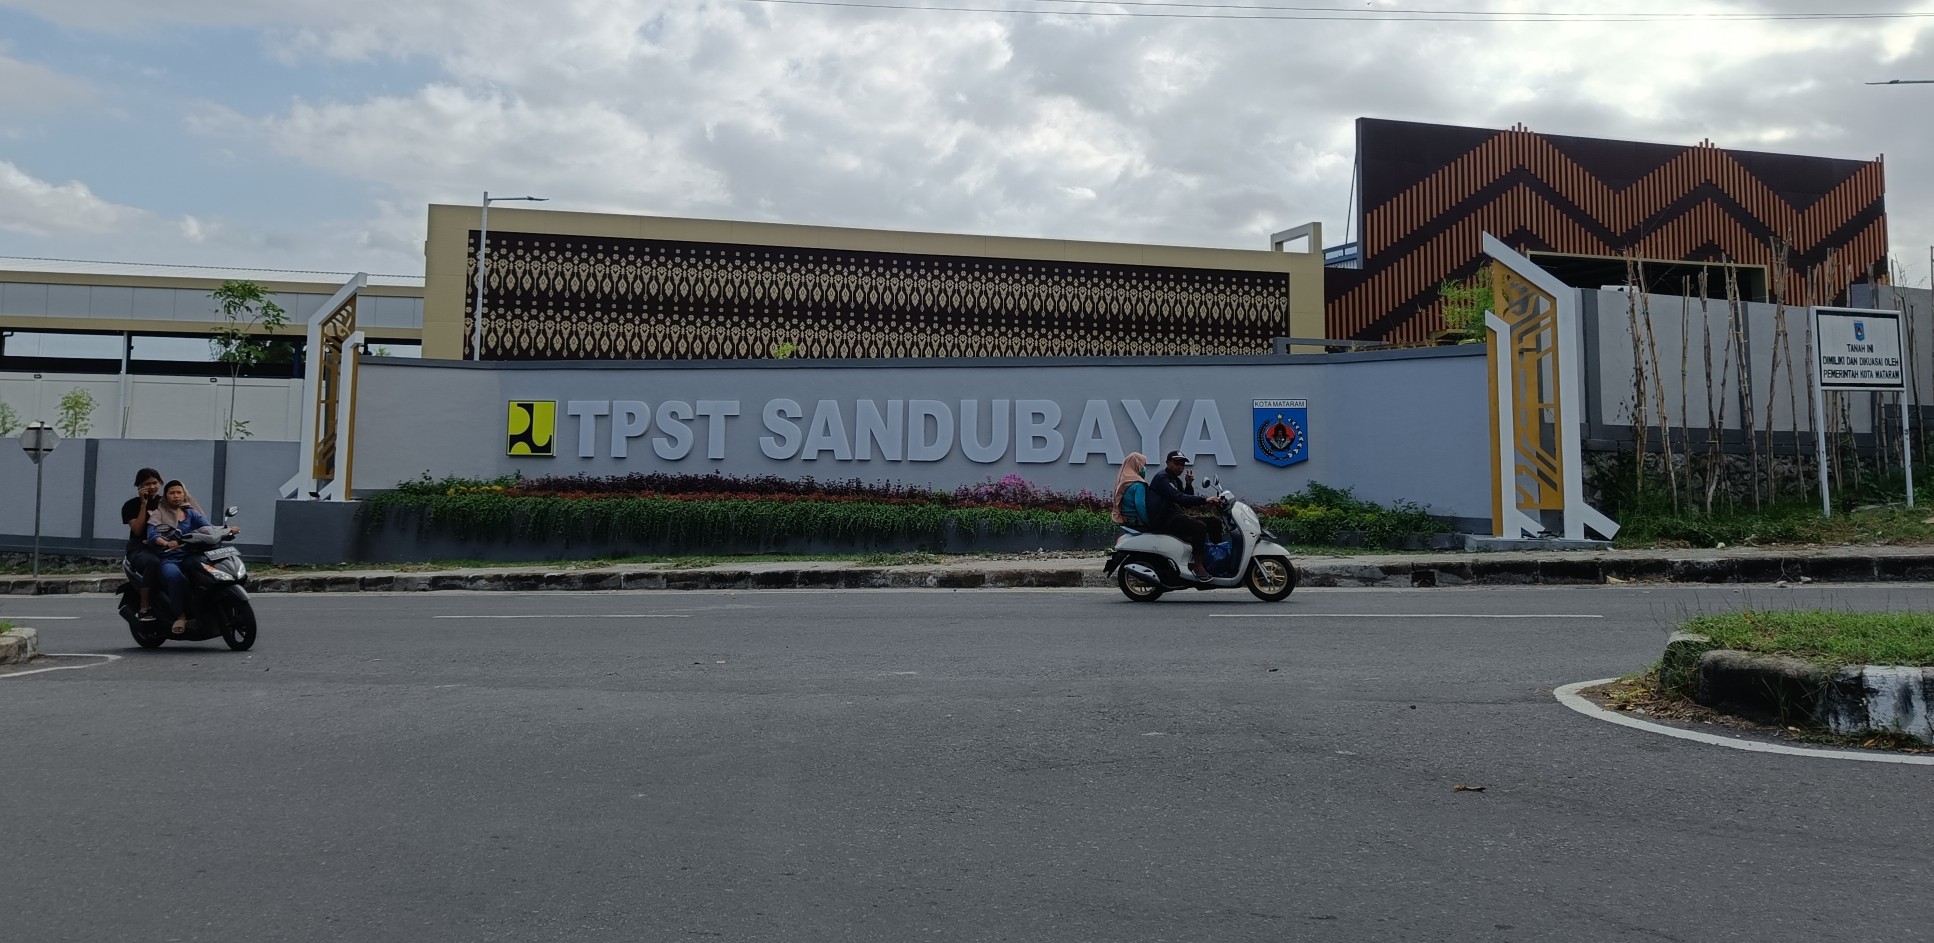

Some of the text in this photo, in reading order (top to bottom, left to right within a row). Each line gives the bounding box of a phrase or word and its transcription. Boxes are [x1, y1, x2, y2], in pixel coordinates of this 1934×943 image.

[1847, 344, 1866, 352] TANAH
[1823, 356, 1899, 366] DIMILIKI DAN DIKUASAI OLEH
[1824, 370, 1899, 379] PEMERINTAH KOTA MATARAM
[567, 398, 1237, 467] TPST SANDUBAYA
